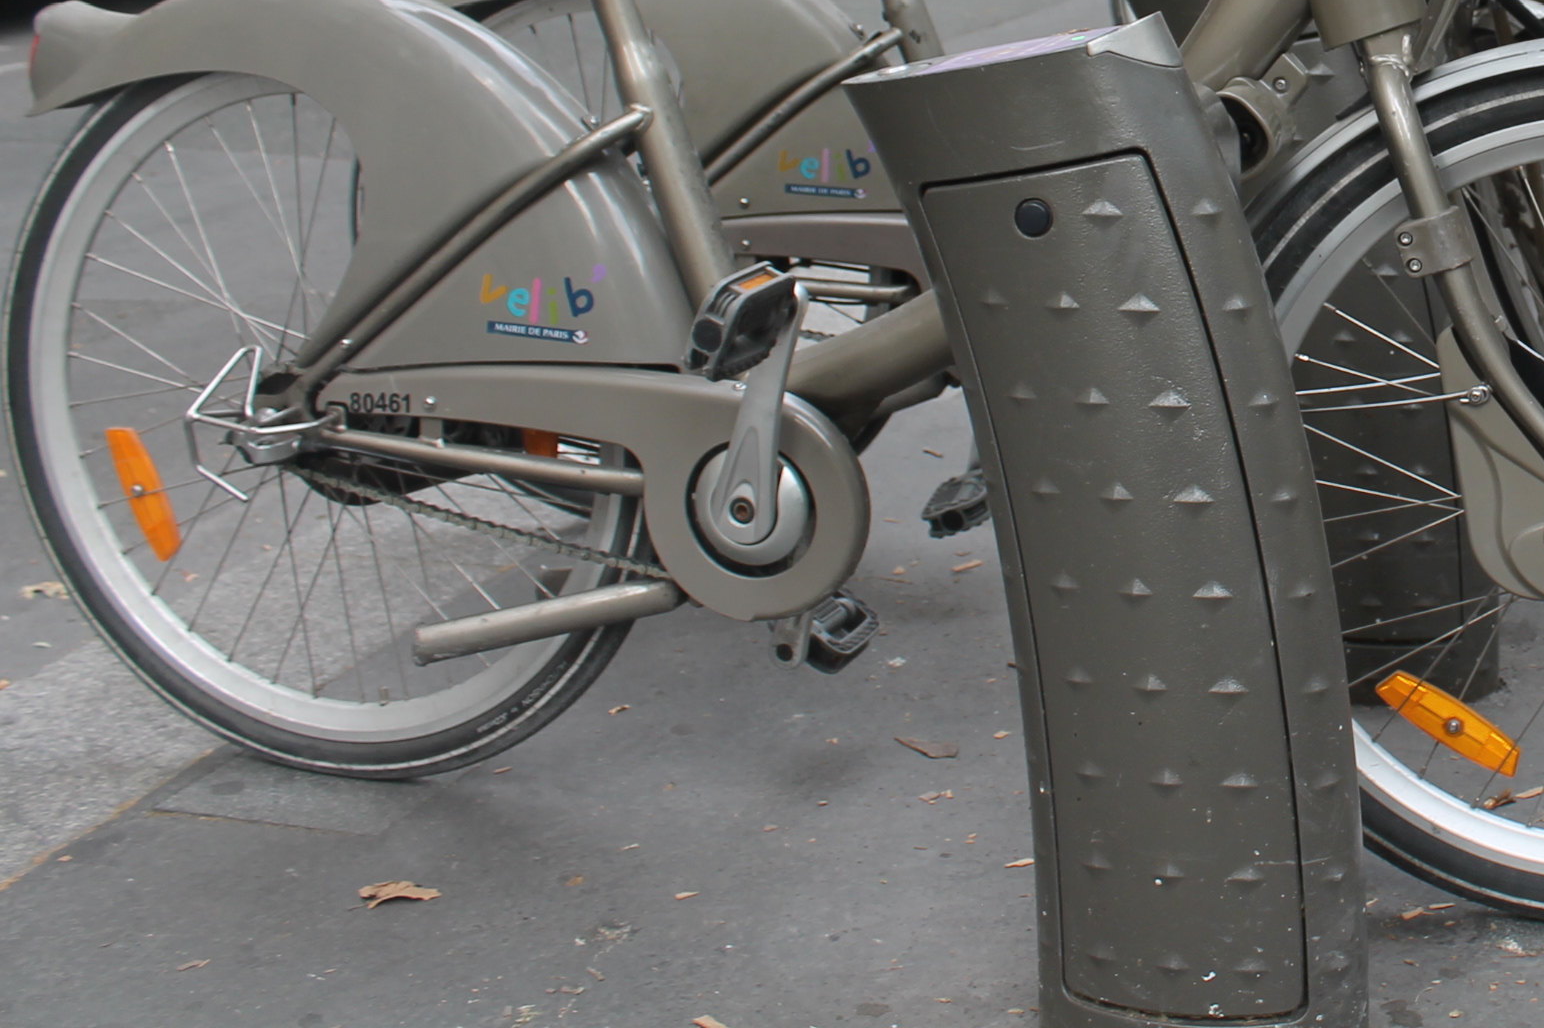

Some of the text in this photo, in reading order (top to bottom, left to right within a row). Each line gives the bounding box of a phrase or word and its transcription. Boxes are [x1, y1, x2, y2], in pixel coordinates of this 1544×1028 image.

[494, 322, 569, 340] MAIRIE DE PARIS
[350, 392, 410, 413] 80461
